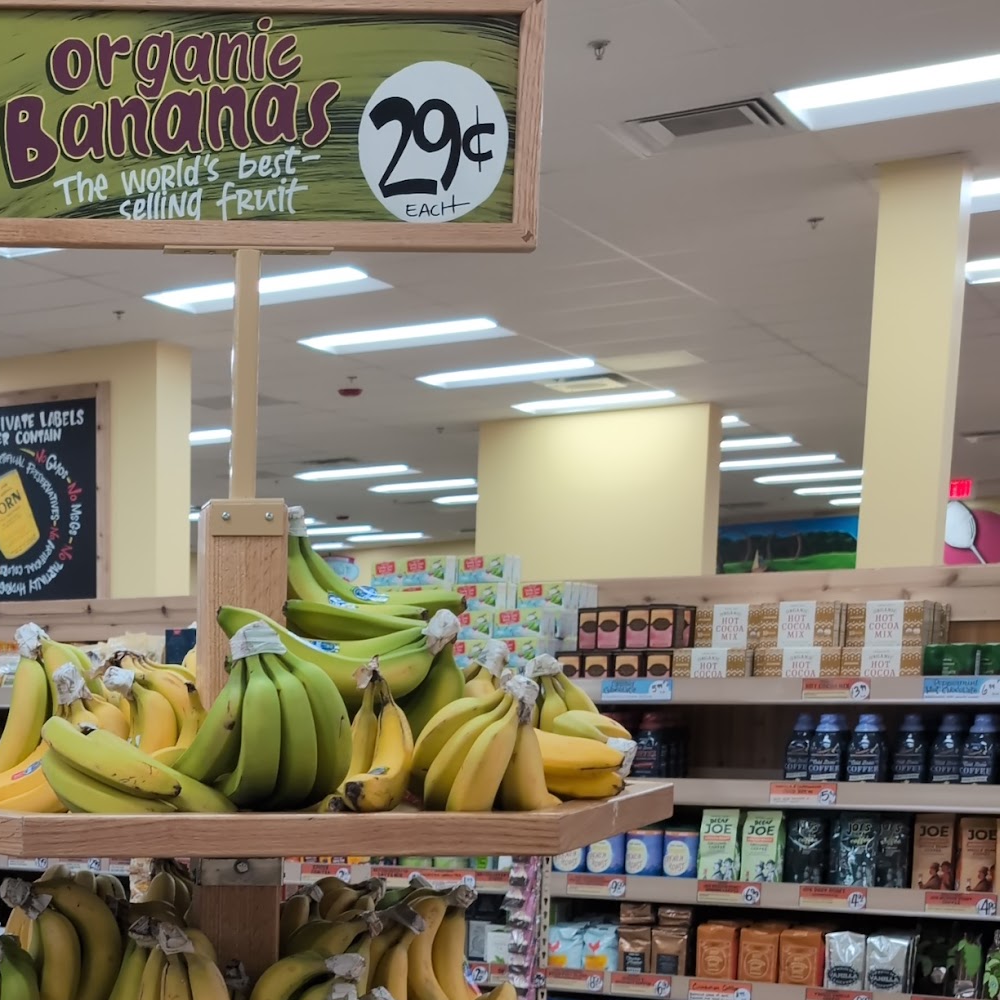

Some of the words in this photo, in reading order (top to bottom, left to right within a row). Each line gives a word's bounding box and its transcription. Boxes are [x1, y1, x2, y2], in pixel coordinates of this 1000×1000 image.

[49, 16, 303, 100] organic
[4, 79, 341, 185] Bananas
[369, 96, 495, 198] 29¢
[53, 171, 108, 205] The
[405, 197, 470, 219] EACH
[40, 409, 84, 427] LABELS
[15, 429, 61, 444] CONTAIN
[26, 462, 59, 520] PRESERVATIVES
[871, 660, 890, 668] HOT
[704, 824, 732, 834] JOE
[748, 826, 775, 835] JOE
[920, 825, 949, 837] JOE
[968, 829, 996, 841] JOE
